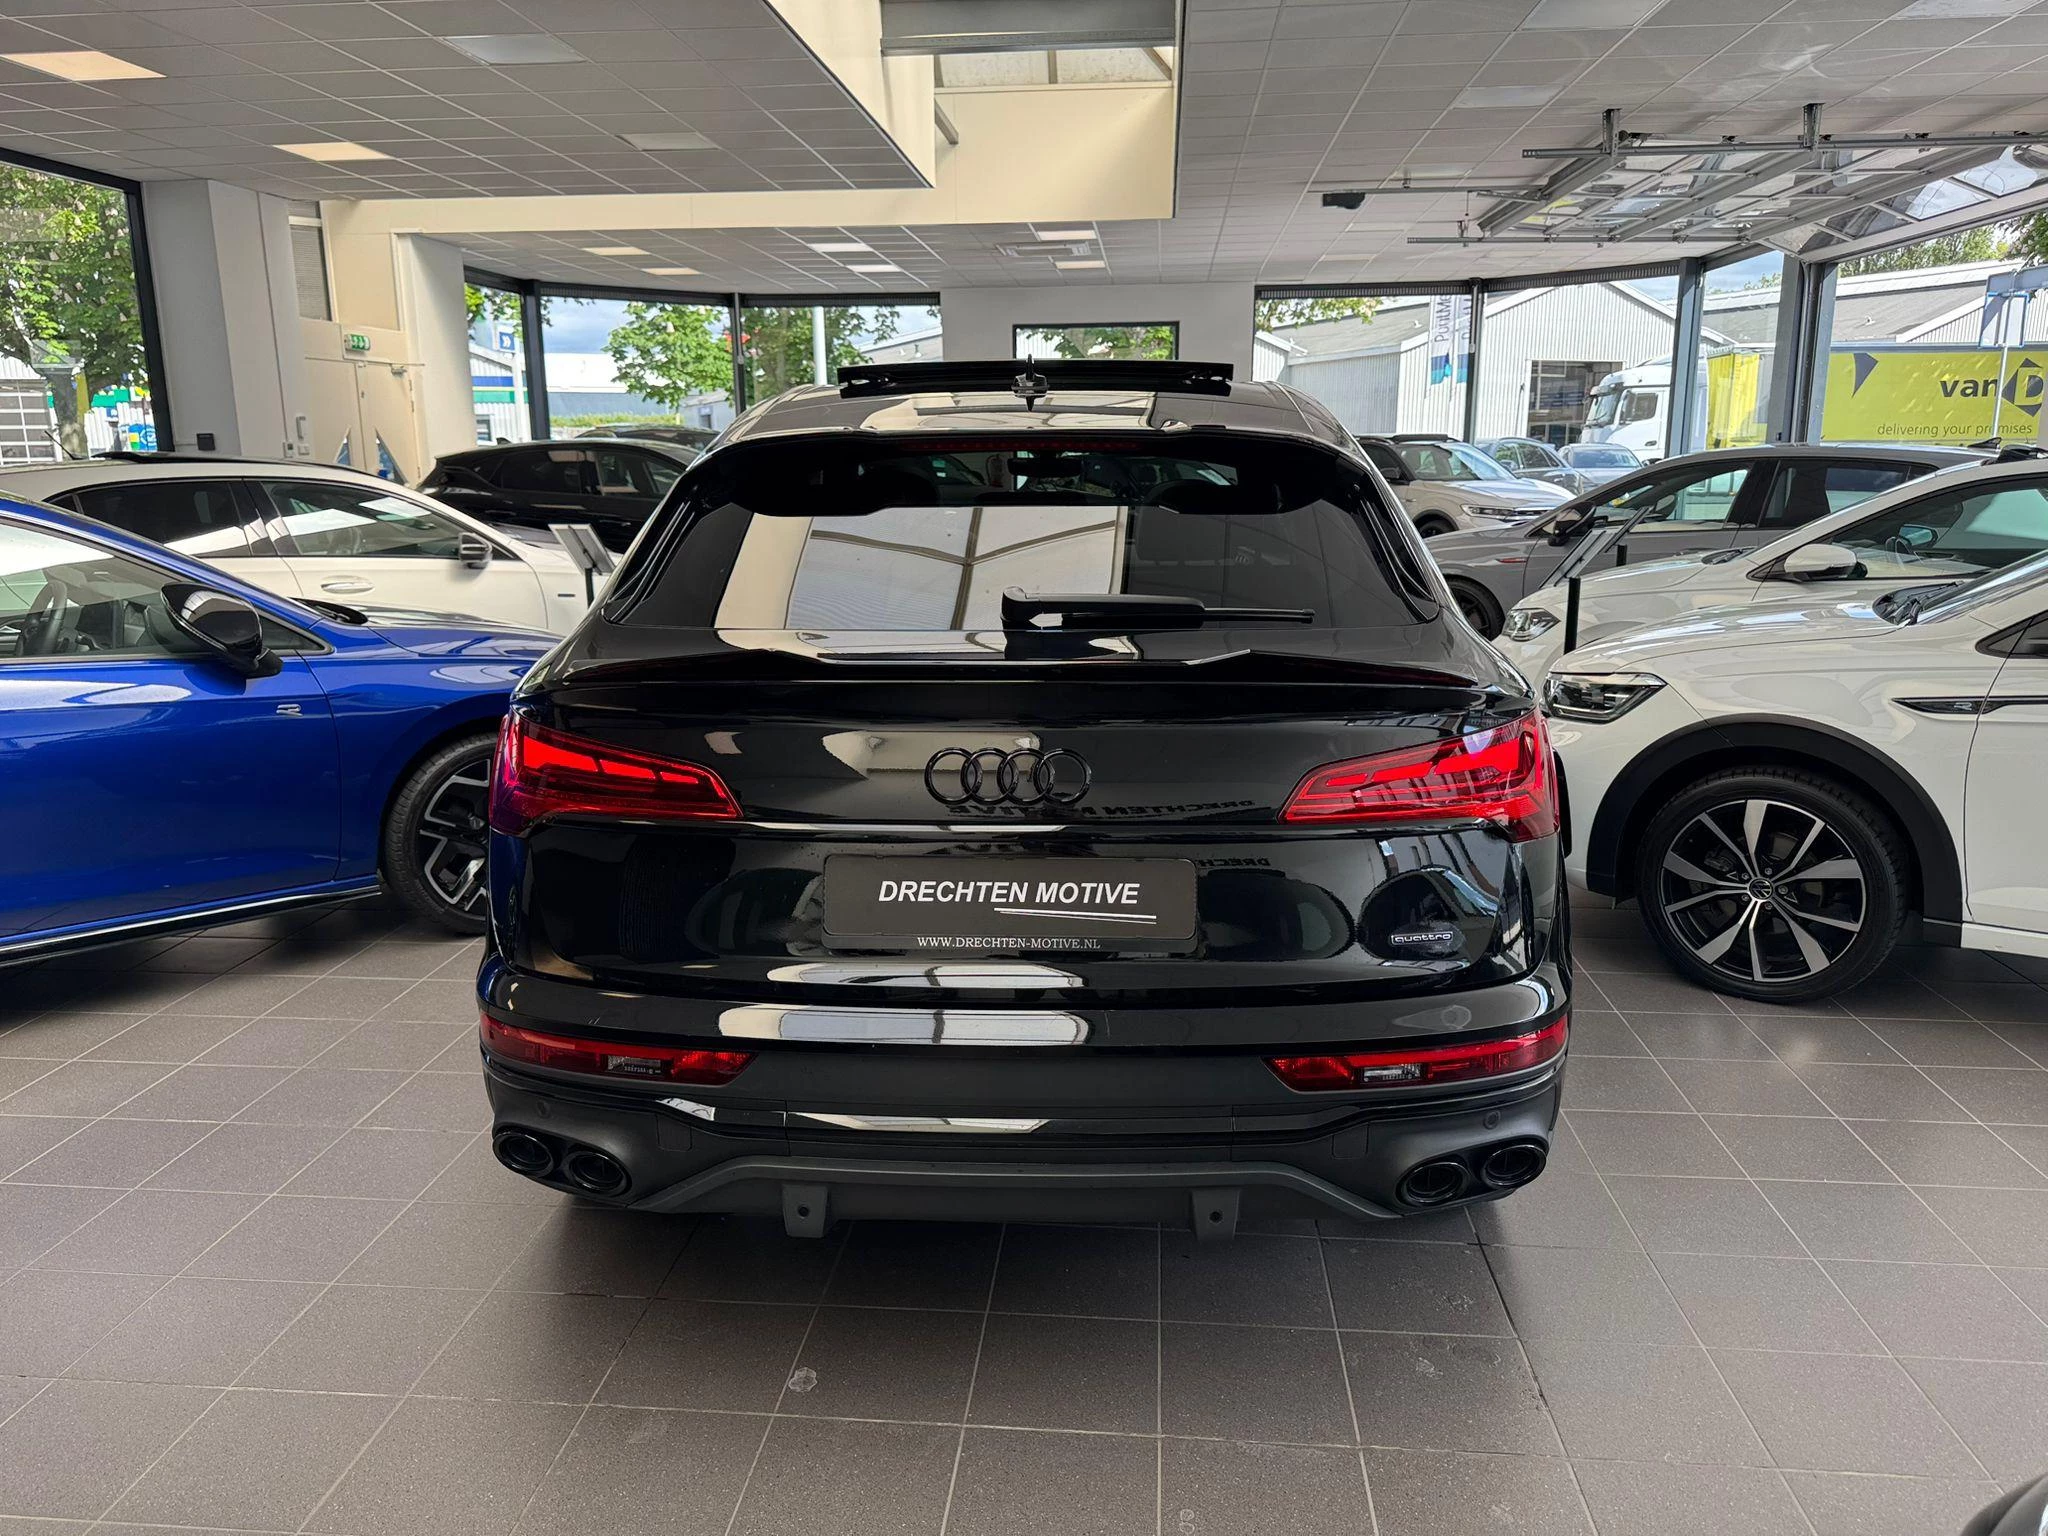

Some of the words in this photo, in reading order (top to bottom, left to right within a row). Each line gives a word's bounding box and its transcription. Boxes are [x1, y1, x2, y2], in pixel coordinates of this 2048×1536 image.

[1940, 378, 1998, 398] van
[1877, 423, 1938, 437] delivering
[1943, 425, 1971, 437] your
[878, 880, 1028, 903] DRECHTEN
[1035, 882, 1140, 904] MOTIVE
[917, 937, 1101, 949] WWW.DRECHTEN-MOTIVE.NL
[1394, 933, 1451, 943] quattro
